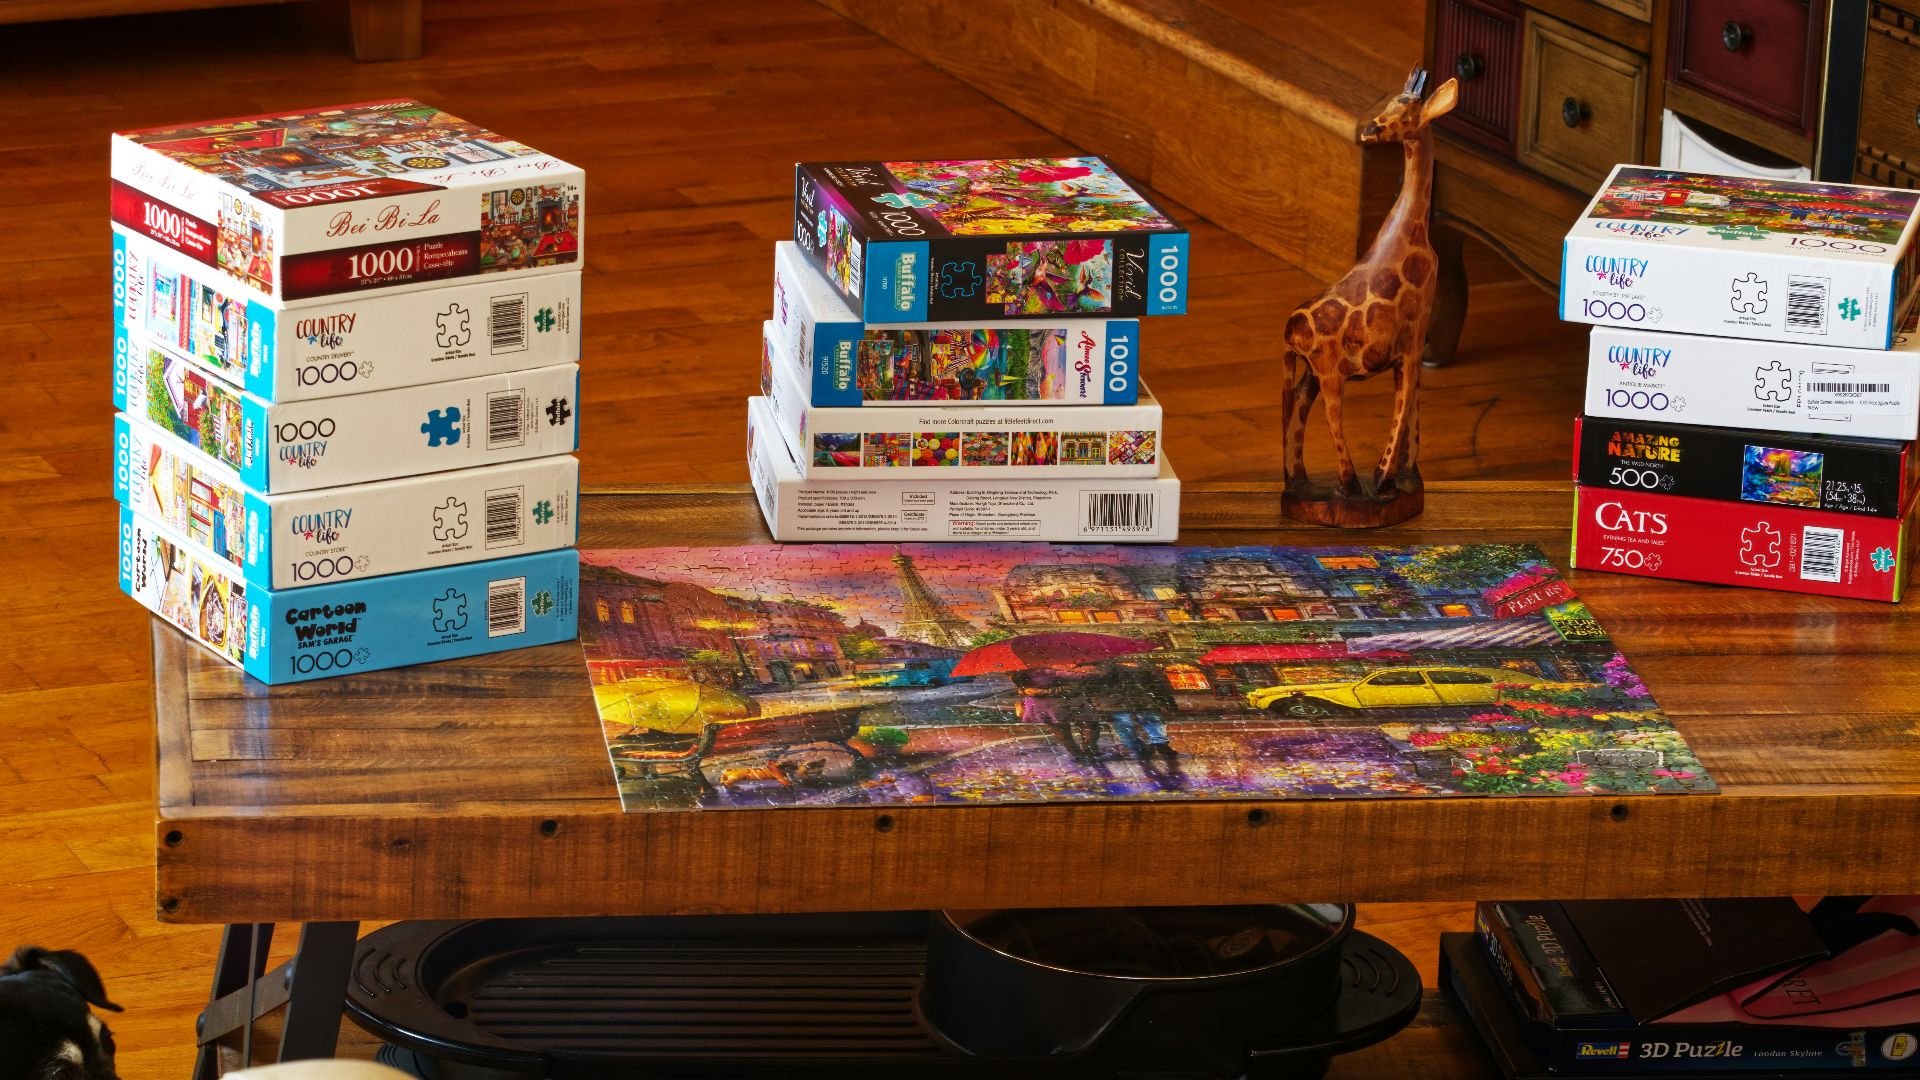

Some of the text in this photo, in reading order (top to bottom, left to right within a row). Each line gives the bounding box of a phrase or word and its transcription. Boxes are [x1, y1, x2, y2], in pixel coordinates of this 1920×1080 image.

[284, 185, 380, 204] 1000
[567, 184, 577, 192] 14+
[144, 200, 181, 239] 1000
[326, 199, 441, 238] Bei Bi La
[880, 211, 926, 236] 1000
[1595, 220, 1690, 236] COUNTRY
[424, 242, 444, 251] Puzzle
[424, 248, 469, 261] Rompecabezas
[1787, 237, 1887, 254] 1000
[348, 246, 414, 280] 1000
[1125, 248, 1145, 300] Vivid
[1159, 245, 1179, 303] 1000
[1585, 255, 1649, 278] COUNTRY
[114, 248, 125, 308] 1000
[900, 252, 917, 312] Buffalo
[1609, 272, 1632, 290] life
[1582, 298, 1646, 322] 1000
[296, 312, 356, 340] COUNTRY
[320, 332, 342, 350] life
[116, 336, 127, 396] 1000
[306, 354, 330, 363] COUNTRY
[838, 341, 853, 390] Buffalo
[1074, 330, 1096, 398] Aimee Stewart
[1109, 335, 1129, 392] 1000
[1608, 345, 1672, 368] COUNTRY
[296, 361, 358, 388] 1000
[1632, 362, 1655, 380] life
[1618, 380, 1642, 388] ANTIQUE
[1606, 388, 1669, 411] 1000
[274, 417, 336, 444] 1000
[919, 417, 931, 425] Find
[947, 417, 975, 425] Colorcraft
[975, 417, 996, 426] puzzles
[1610, 431, 1680, 447] AMAZING
[118, 432, 129, 491] 1000
[280, 440, 327, 462] COUNTRY
[1608, 442, 1681, 463] NATURE
[298, 456, 316, 470] life
[1631, 460, 1645, 468] WILD
[1608, 467, 1659, 489] 500
[291, 508, 352, 535] COUNTRY
[1595, 501, 1668, 535] CATS
[316, 528, 338, 545] life
[1603, 534, 1627, 542] EVENING
[122, 523, 132, 581] 1000
[305, 546, 346, 558] COUNTRY STORE
[1600, 546, 1644, 568] 750
[291, 555, 354, 582] 1000
[1507, 584, 1562, 613] FLEURS
[285, 600, 366, 625] Cartoon
[294, 618, 358, 642] World
[297, 635, 353, 650] SAM'S GARAGE
[290, 648, 353, 675] 1000
[1580, 1040, 1823, 1058] Revell 3D Puzzle London Skyline
